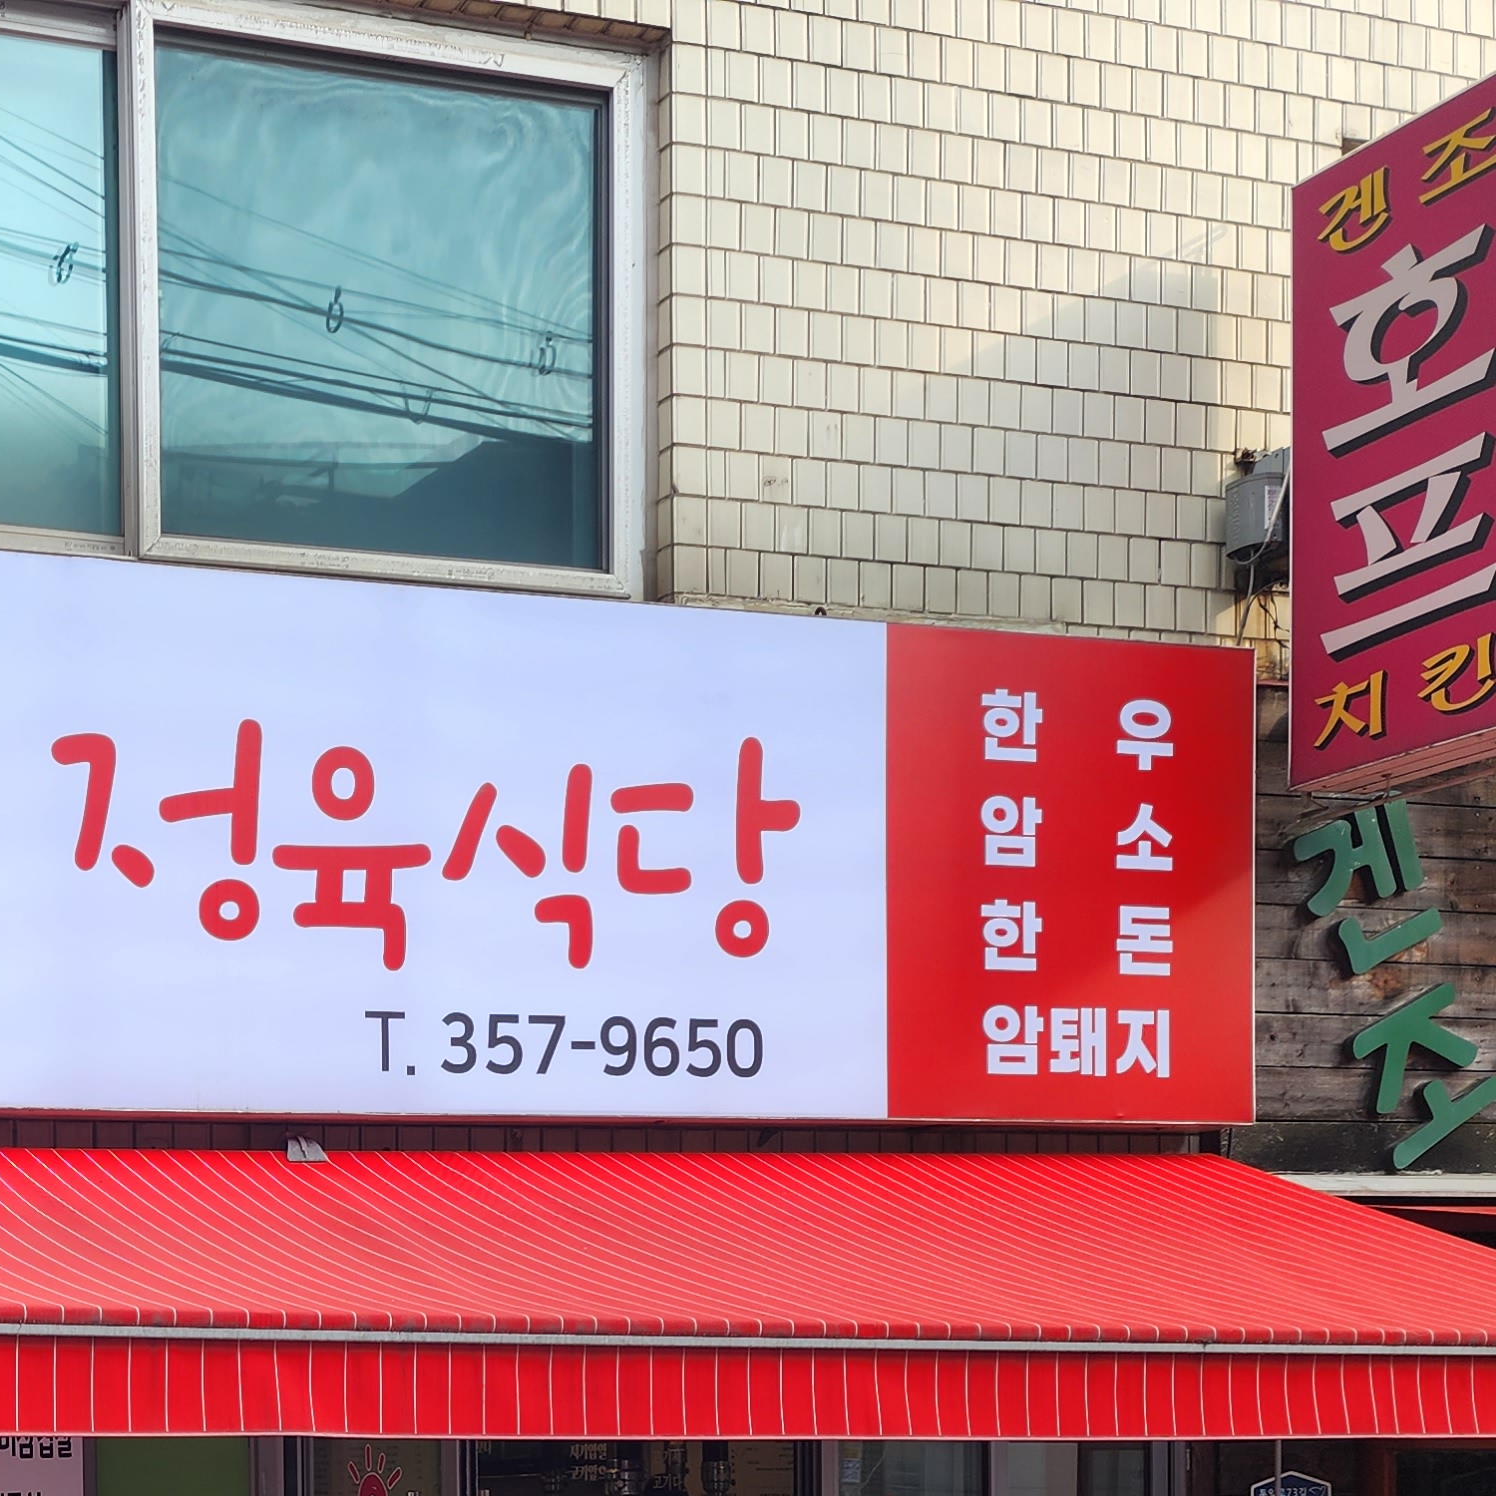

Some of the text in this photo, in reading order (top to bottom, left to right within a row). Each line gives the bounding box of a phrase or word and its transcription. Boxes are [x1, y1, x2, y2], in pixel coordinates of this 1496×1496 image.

[1320, 224, 1496, 655] 호프
[1313, 632, 1496, 749] 치킨
[51, 718, 801, 971] 정육식당
[440, 1011, 763, 1078] 357-9650
[982, 1004, 1170, 1078] 암퇘지
